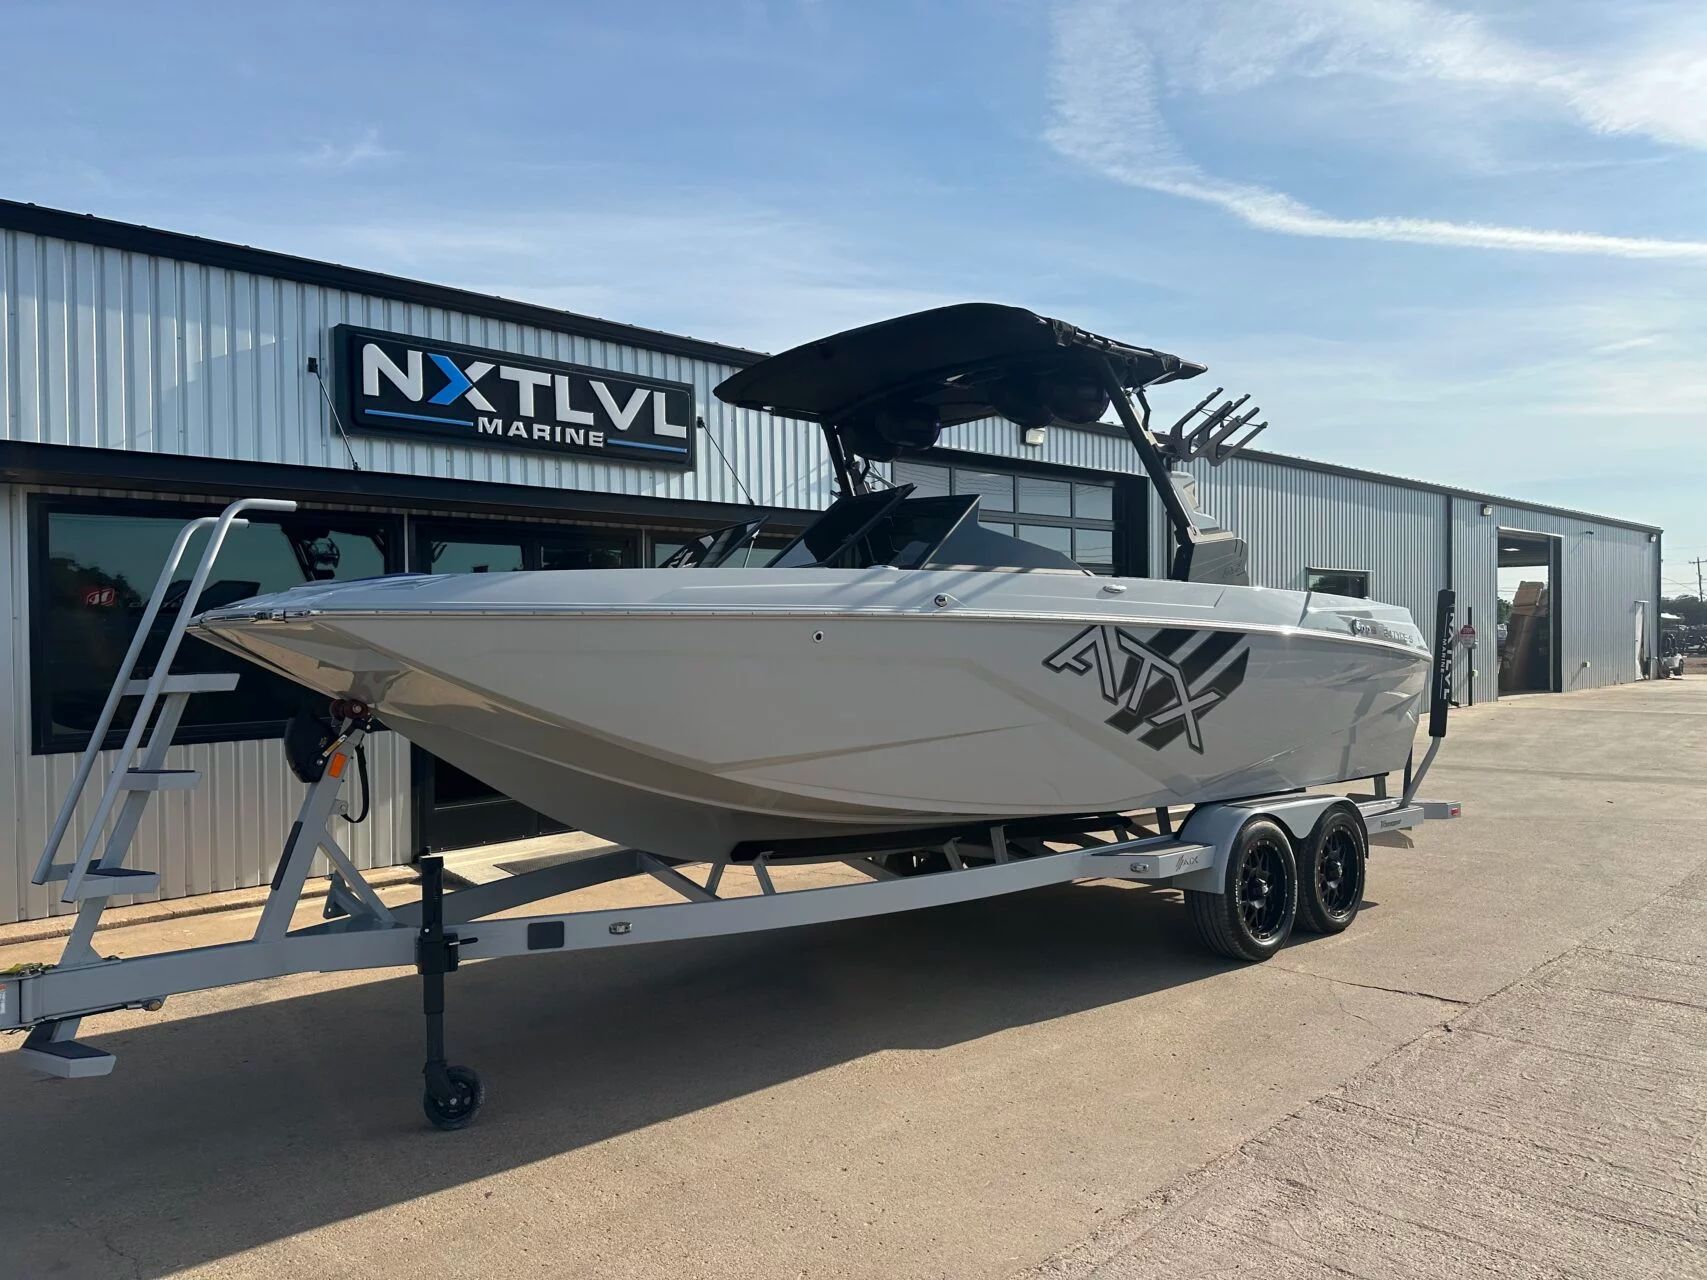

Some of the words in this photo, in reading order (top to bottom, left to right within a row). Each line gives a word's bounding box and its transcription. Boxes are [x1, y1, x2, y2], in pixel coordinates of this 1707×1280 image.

[363, 343, 687, 439] NXTLVL
[477, 416, 604, 448] MARINE
[1042, 624, 1227, 755] ATX
